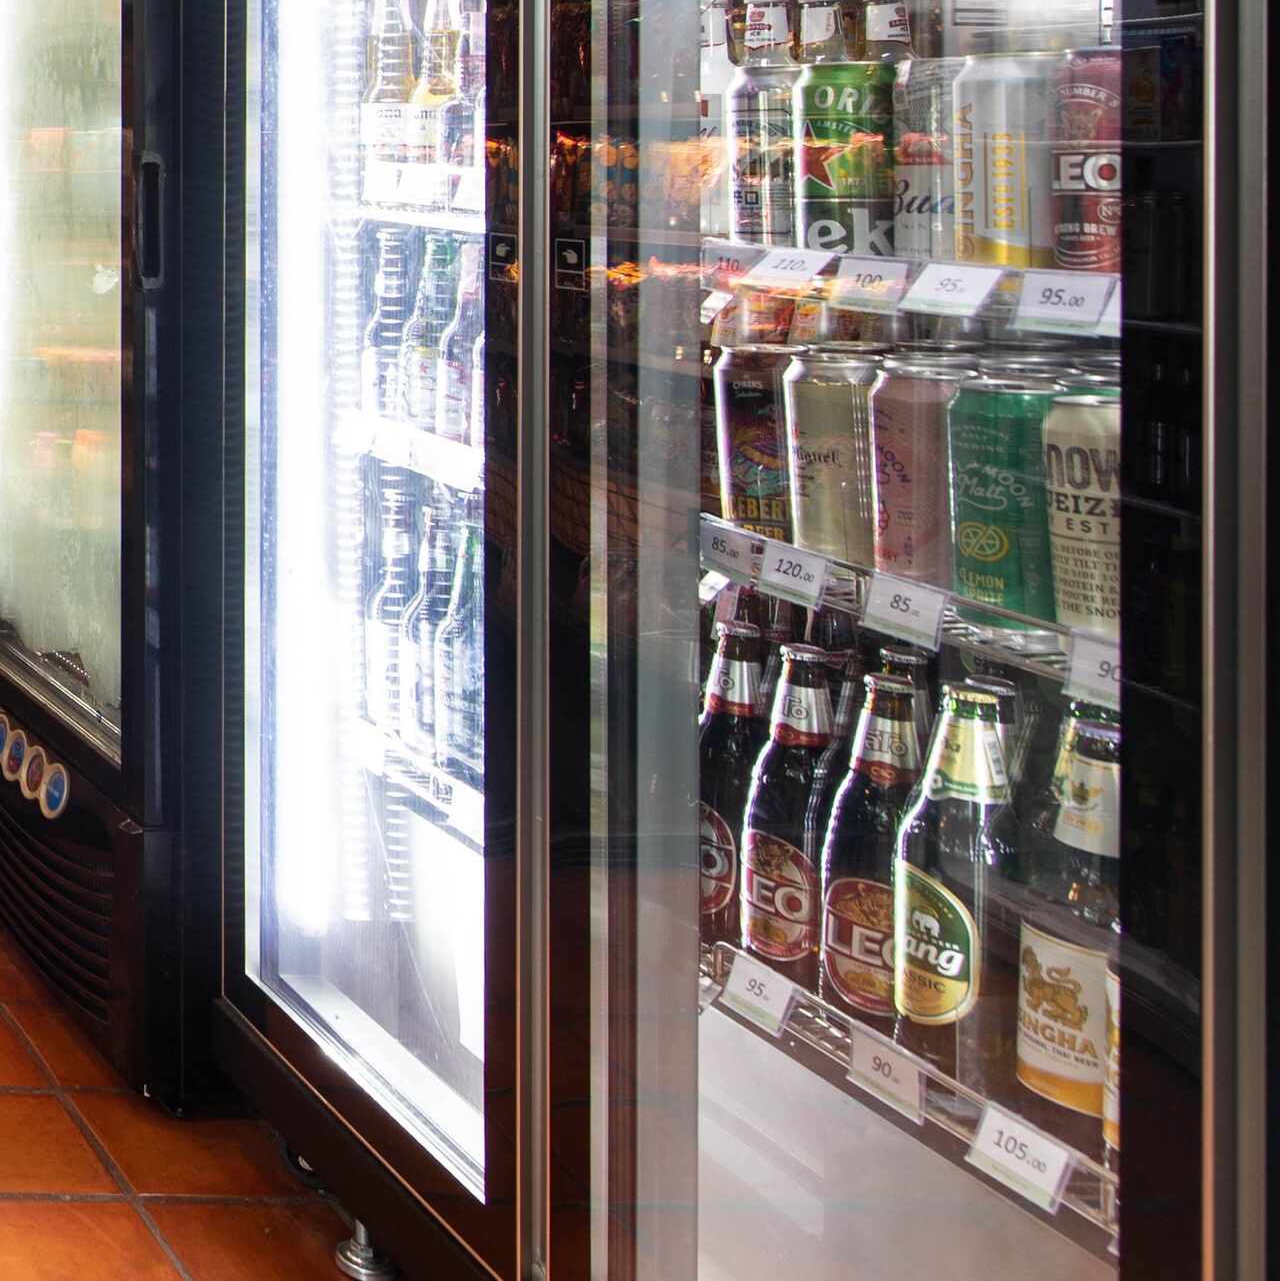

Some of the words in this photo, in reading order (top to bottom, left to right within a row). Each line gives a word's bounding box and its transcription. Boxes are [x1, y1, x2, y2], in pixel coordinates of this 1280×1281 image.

[1083, 222, 1117, 236] BREW
[1039, 287, 1085, 307] 95.00
[711, 536, 739, 560] 85.00
[774, 557, 816, 584] 120.00
[961, 569, 1005, 590] LEMON
[1061, 601, 1083, 615] THE
[751, 872, 810, 923] EO
[1051, 1048, 1071, 1063] THAI
[1074, 1054, 1099, 1070] BEER
[992, 1129, 1048, 1174] 105.00
